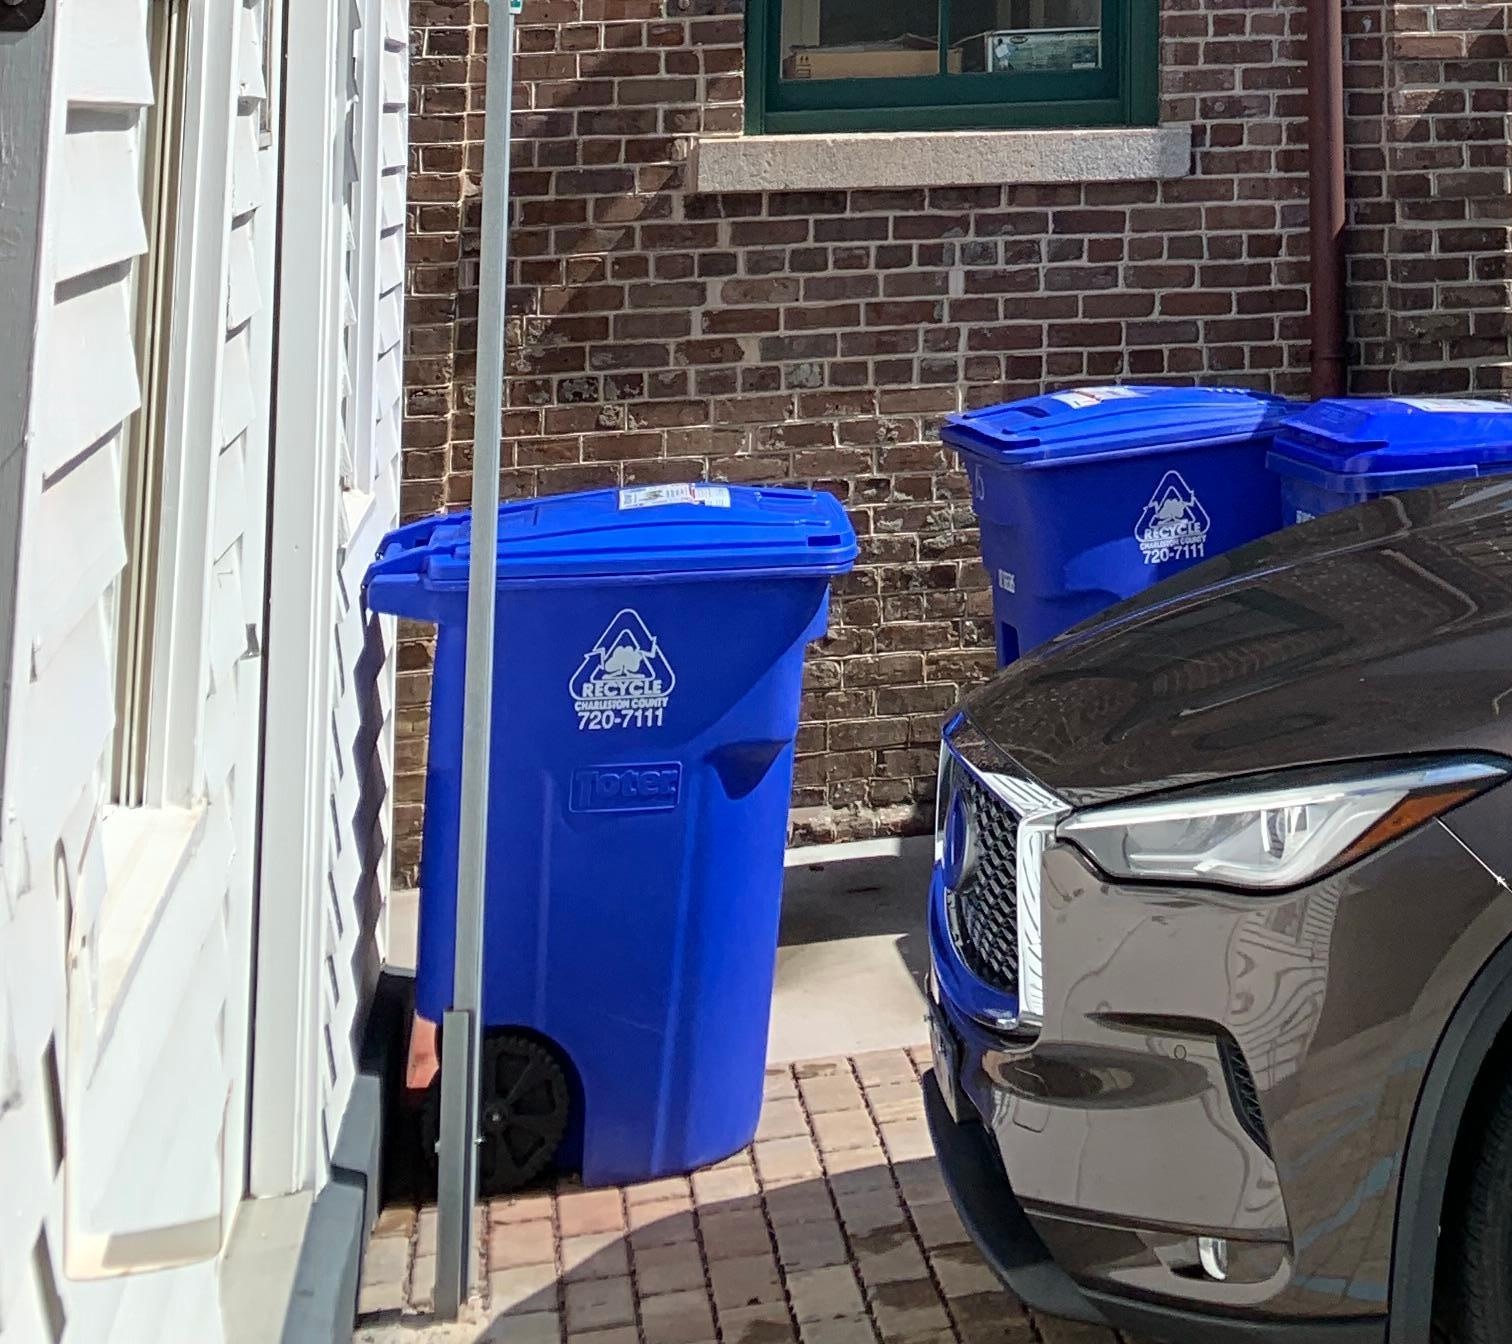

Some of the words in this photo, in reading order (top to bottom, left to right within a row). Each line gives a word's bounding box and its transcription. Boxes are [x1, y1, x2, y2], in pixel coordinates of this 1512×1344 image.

[1144, 520, 1201, 541] RECYCLE
[1143, 543, 1204, 565] 720-7111
[582, 679, 663, 698] RECYCLE
[574, 699, 630, 712] CHARLESTON
[631, 696, 669, 708] COUNTY
[578, 708, 663, 730] 720-7111
